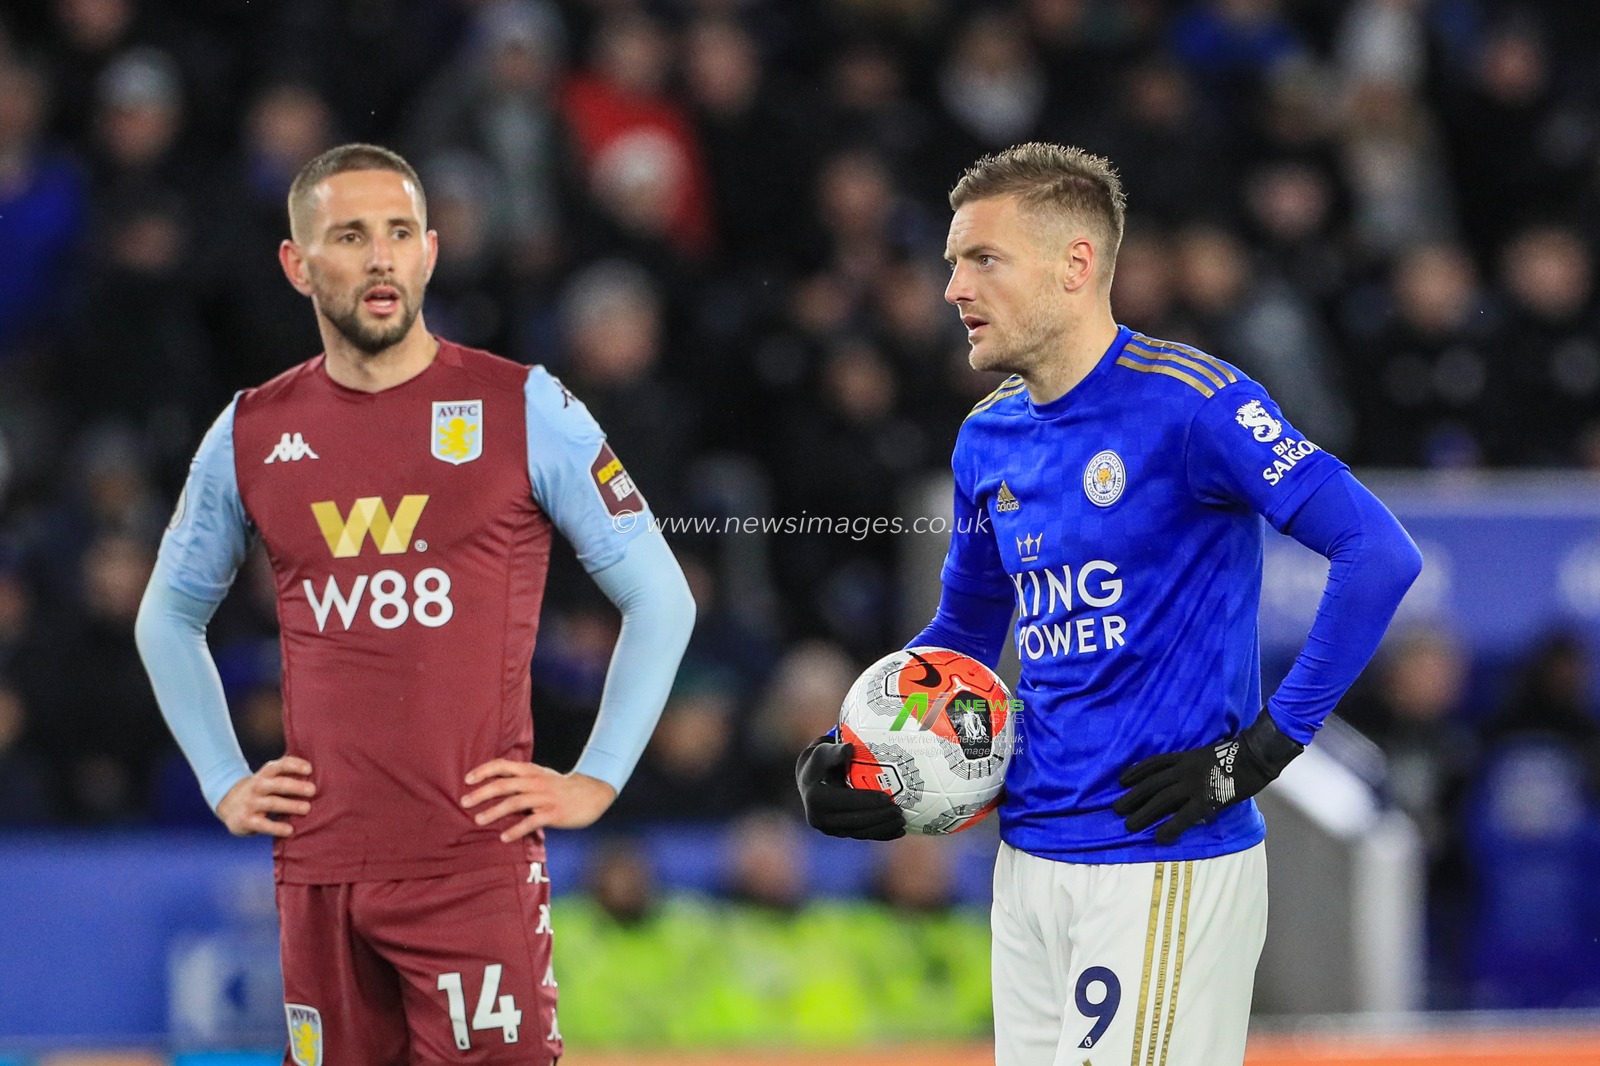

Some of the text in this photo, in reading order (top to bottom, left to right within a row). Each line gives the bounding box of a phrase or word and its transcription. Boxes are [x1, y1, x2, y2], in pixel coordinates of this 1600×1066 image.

[438, 404, 478, 418] AVFC
[1271, 437, 1296, 457] BIA
[996, 500, 1020, 512] adidas
[302, 567, 454, 633] W88
[437, 964, 522, 1050] 14
[1075, 966, 1121, 1049] 9
